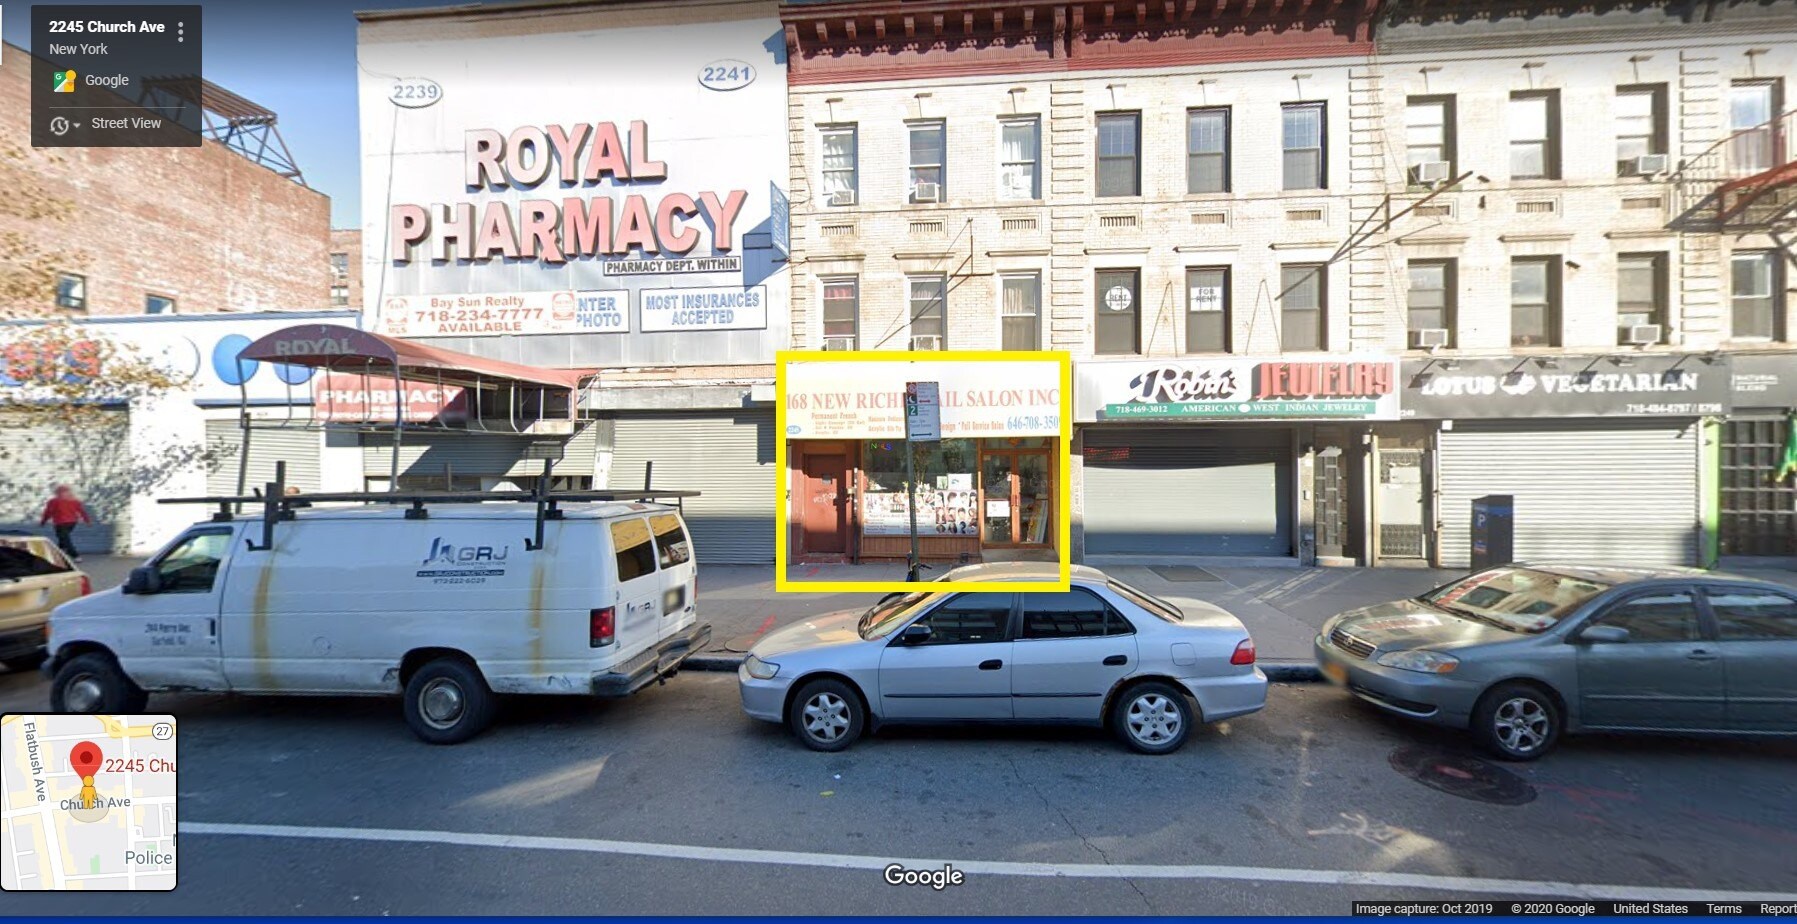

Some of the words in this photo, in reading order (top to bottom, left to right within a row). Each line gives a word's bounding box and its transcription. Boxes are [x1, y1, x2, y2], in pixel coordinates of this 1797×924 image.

[704, 66, 749, 81] 2241
[394, 84, 437, 98] 2239
[465, 119, 668, 192] ROYAL
[391, 189, 749, 268] PHARMACY
[606, 262, 663, 273] PHARMACY
[665, 260, 694, 271] DEPT.
[697, 258, 738, 270] WITHIN
[431, 297, 455, 309] Bay
[458, 295, 482, 308] Sun
[485, 295, 524, 308] Realty
[646, 295, 679, 310] MOST
[682, 292, 760, 308] INSURANCES
[415, 307, 544, 322] 718-234-7777
[671, 310, 735, 326] ACCEPTED
[438, 321, 523, 333] AVAILABLE
[275, 338, 357, 355] ROYAL
[1256, 362, 1394, 398] JEWELRY
[786, 393, 807, 409] 168
[812, 393, 851, 409] NEW
[856, 392, 900, 409] RICH
[966, 388, 1023, 407] SALON
[1028, 388, 1059, 405] INC
[1116, 405, 1168, 414] 718-469-3012
[1181, 403, 1236, 412] AMERICAN
[1253, 403, 1280, 412] WEST
[1285, 402, 1318, 411] INDIAN
[1323, 402, 1366, 411] JEWELRY
[1007, 416, 1060, 430] 646-708-350
[1477, 514, 1486, 527] P
[458, 546, 508, 560] GRJ
